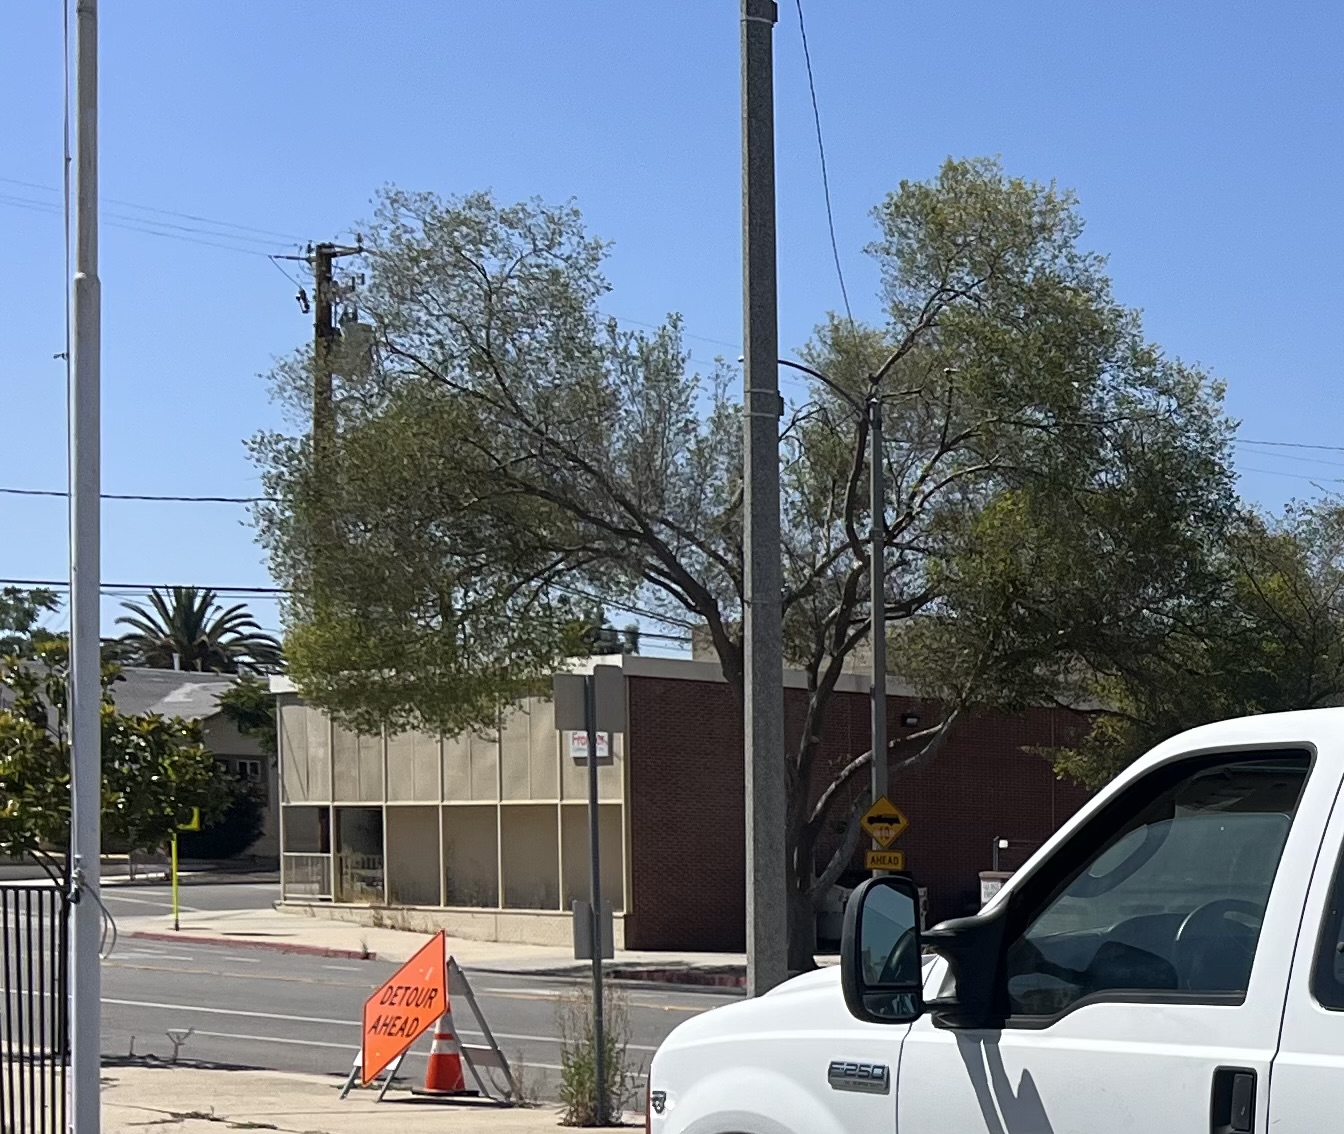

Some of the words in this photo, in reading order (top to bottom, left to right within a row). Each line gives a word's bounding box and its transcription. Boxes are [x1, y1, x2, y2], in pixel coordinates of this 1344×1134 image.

[870, 855, 899, 866] AHEAD
[379, 985, 438, 1009] DETOUR
[367, 1014, 420, 1038] AHEAD
